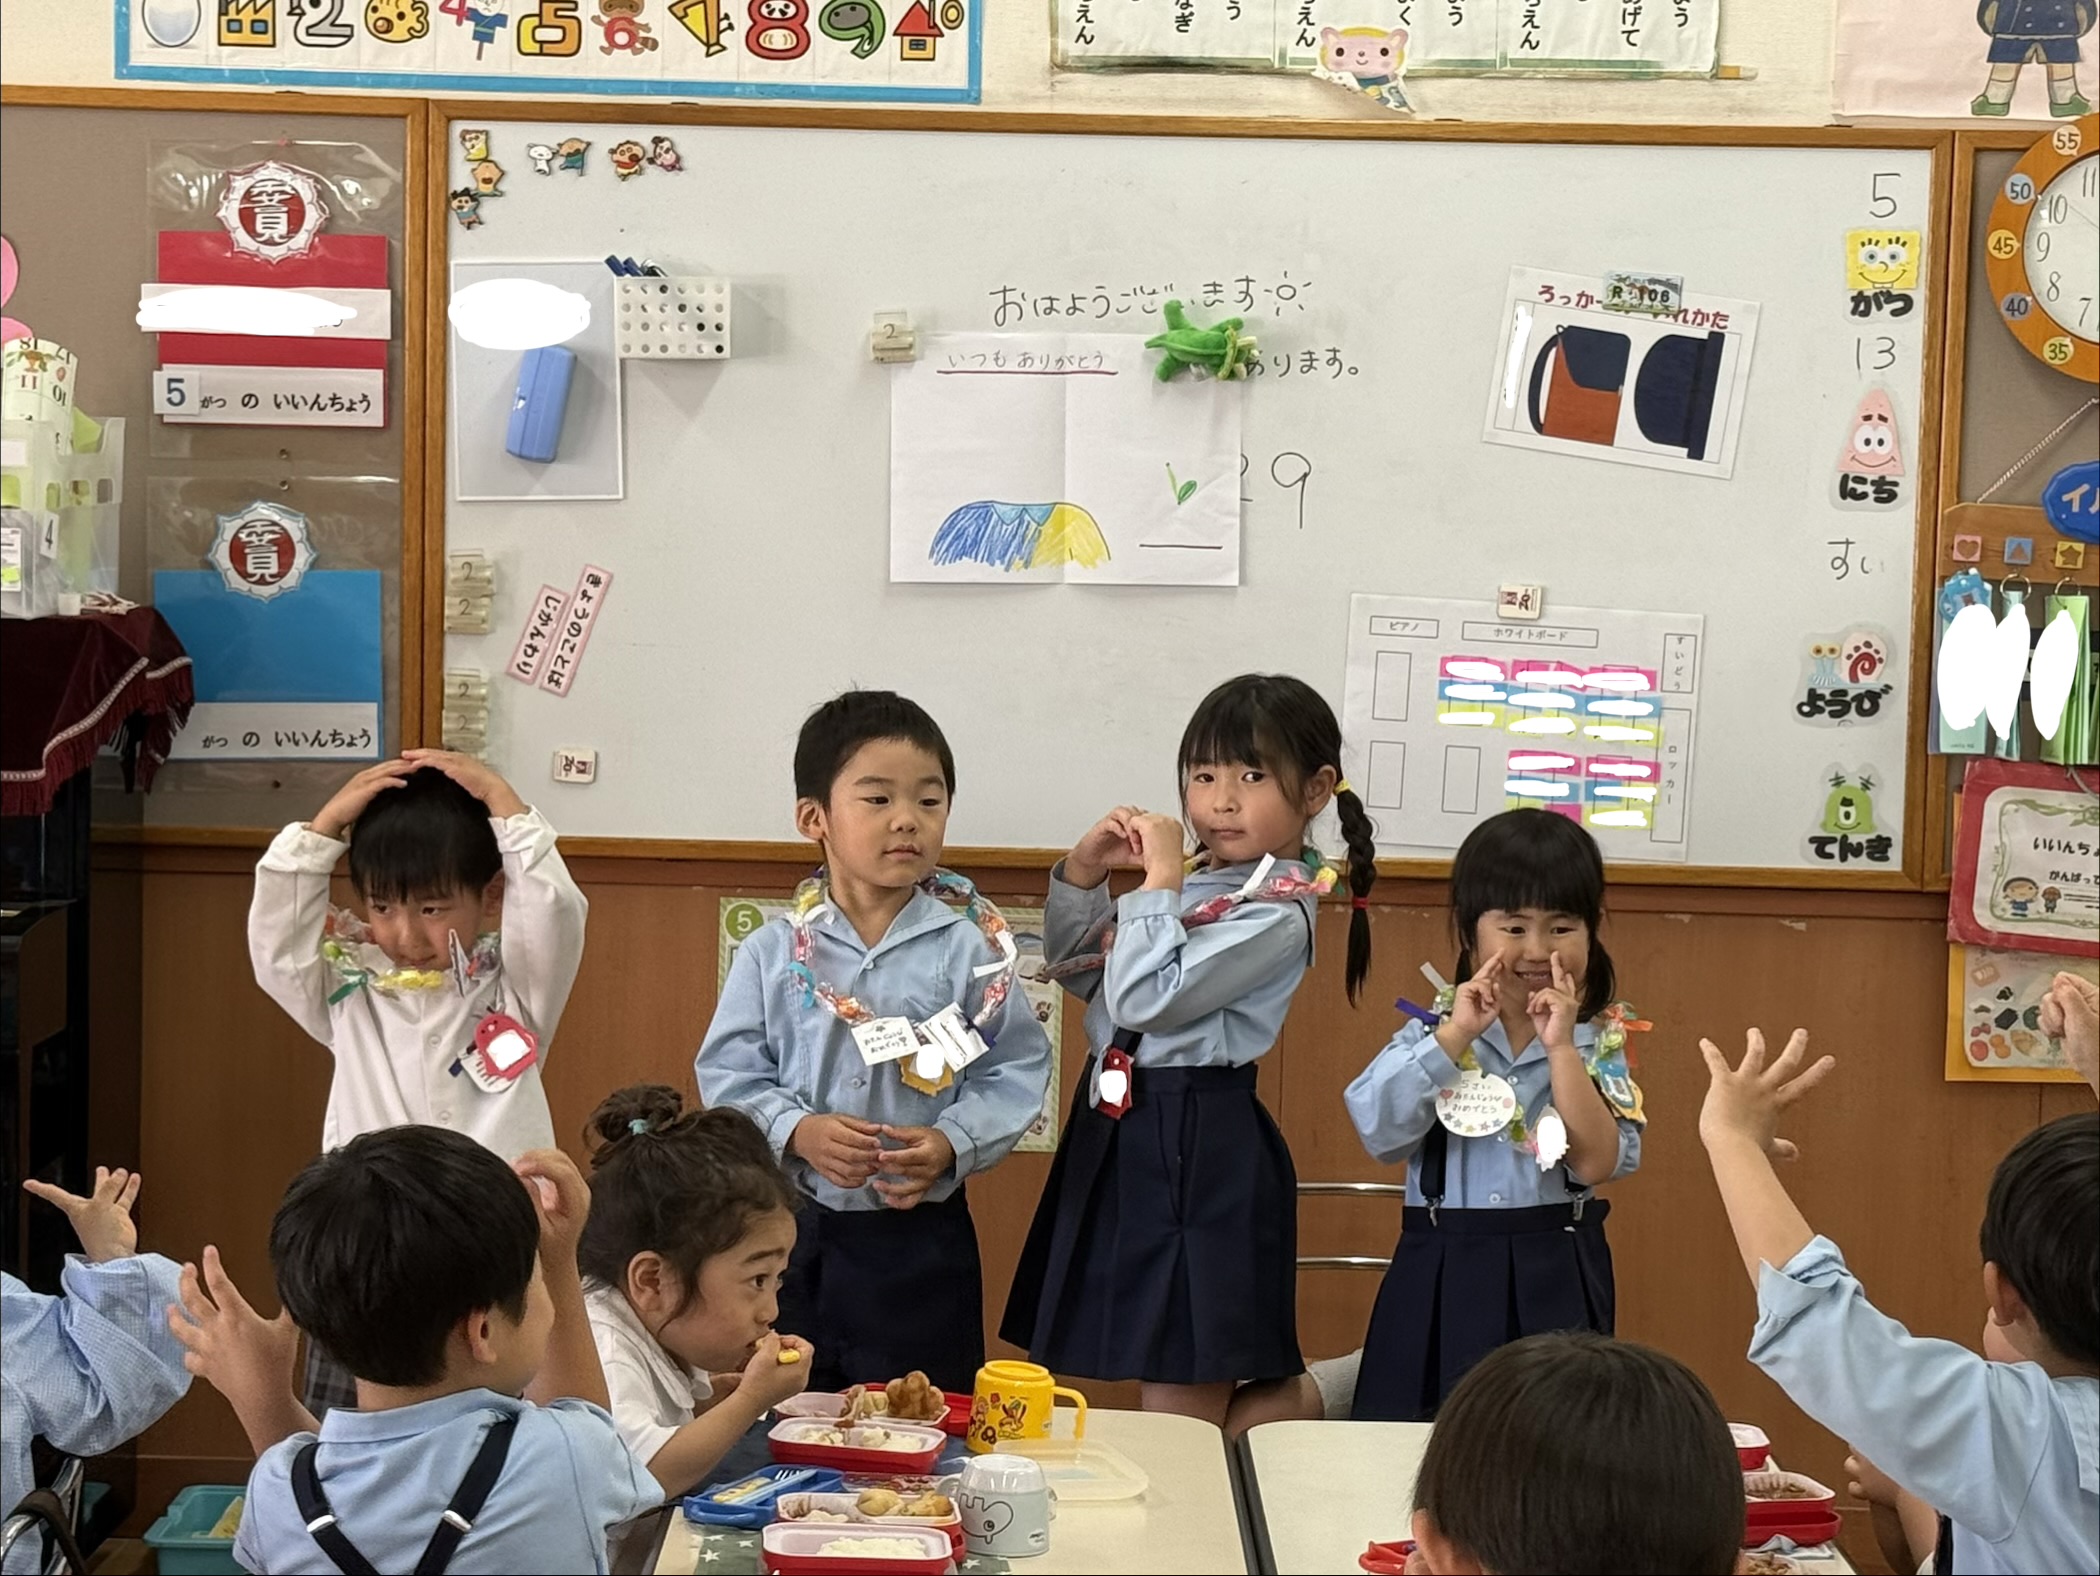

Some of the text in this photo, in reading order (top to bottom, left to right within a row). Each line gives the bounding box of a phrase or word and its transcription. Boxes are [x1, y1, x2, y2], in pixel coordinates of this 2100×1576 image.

[1075, 0, 1095, 45] えん
[1296, 0, 1316, 47] えん
[1397, 0, 1415, 26] く
[1447, 0, 1464, 27] う
[1621, 0, 1643, 47] げて
[1672, 0, 1691, 28] う
[2055, 133, 2080, 150] 55
[1869, 173, 1901, 218] 5
[2010, 182, 2031, 200] 50
[2083, 167, 2096, 197] 11
[2049, 194, 2068, 224] 10
[1992, 237, 2015, 255] 45
[2037, 232, 2050, 262] 9
[2047, 271, 2061, 302] 8
[1850, 290, 1914, 318] がつ
[2005, 297, 2028, 316] 40
[2079, 297, 2093, 327] 7
[883, 323, 898, 340] 2
[949, 350, 1105, 370] いつも ありがとう
[1856, 336, 1896, 372] 13
[2048, 343, 2070, 361] 35
[166, 378, 372, 414] 5 がつ の いいんちょう
[1240, 452, 1312, 530] 9
[1839, 473, 1901, 504] にち
[461, 561, 474, 582] 2
[459, 598, 472, 617] 2
[547, 573, 603, 690] きょうのことば
[1389, 620, 1421, 633] ピアノ
[1493, 627, 1568, 642] ホワイトボード
[1673, 635, 1686, 691] すいどう
[458, 682, 470, 699] 2
[1796, 684, 1894, 719] ようび
[458, 715, 471, 732] 2
[202, 728, 372, 749] がつ の いいんちょう
[1666, 744, 1678, 805] ロッカー
[1807, 834, 1893, 863] てんき
[736, 910, 753, 932] 5
